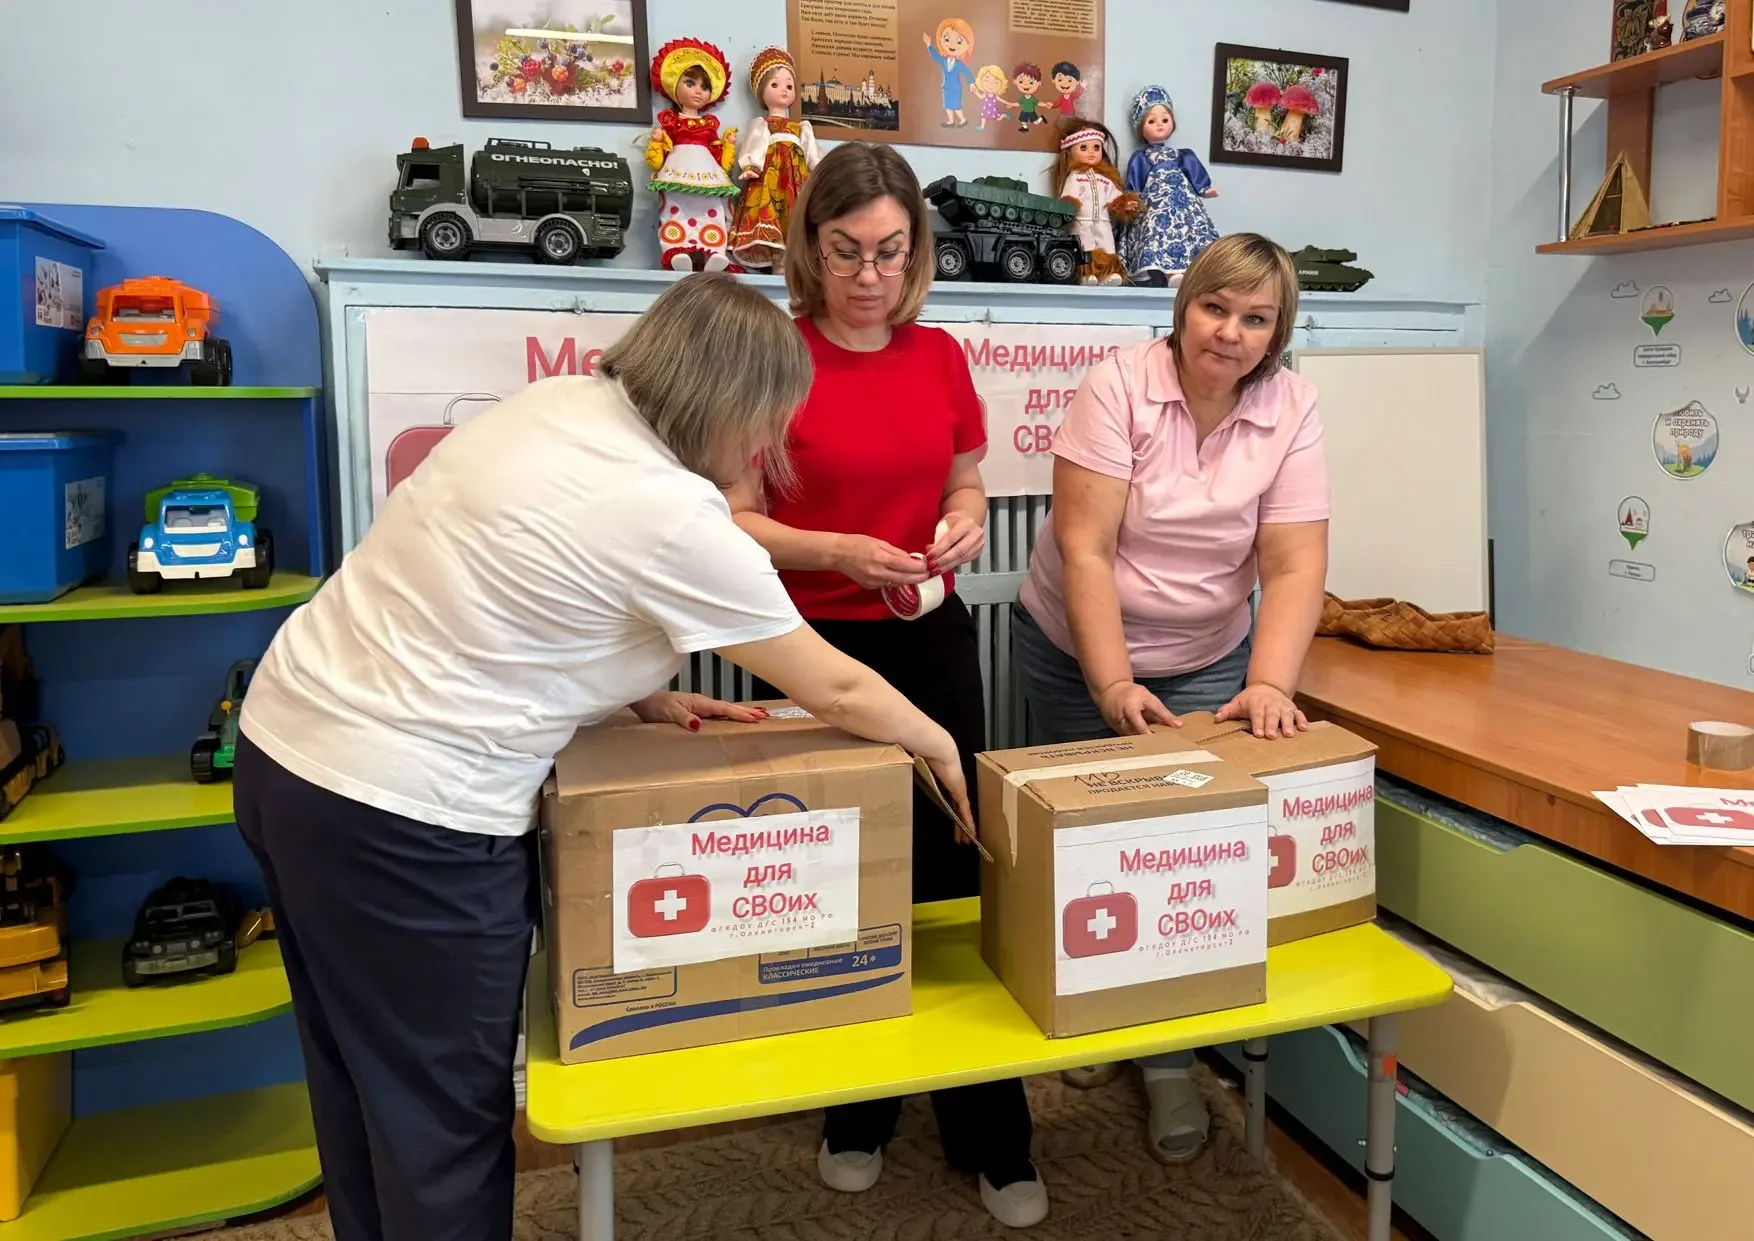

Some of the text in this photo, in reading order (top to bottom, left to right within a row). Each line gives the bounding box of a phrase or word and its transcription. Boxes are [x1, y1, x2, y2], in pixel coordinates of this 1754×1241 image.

[491, 153, 619, 170] ОГНЕОПАСНО!
[1669, 428, 1705, 439] природу
[1672, 418, 1709, 430] охранять
[1282, 784, 1373, 818] Медицина
[691, 824, 830, 856] Медицина
[1320, 820, 1354, 846] для
[1120, 840, 1246, 873] Медицина
[1312, 844, 1369, 873] СВОих
[743, 862, 793, 889] для
[1167, 879, 1212, 905] для
[732, 892, 818, 919] СВОих
[781, 916, 798, 925] 154
[1158, 908, 1236, 937] СВОих
[762, 966, 820, 980] КЛАССИЧЕСКИЕ
[763, 963, 800, 975] Прокладки
[801, 957, 844, 970] ежедневные
